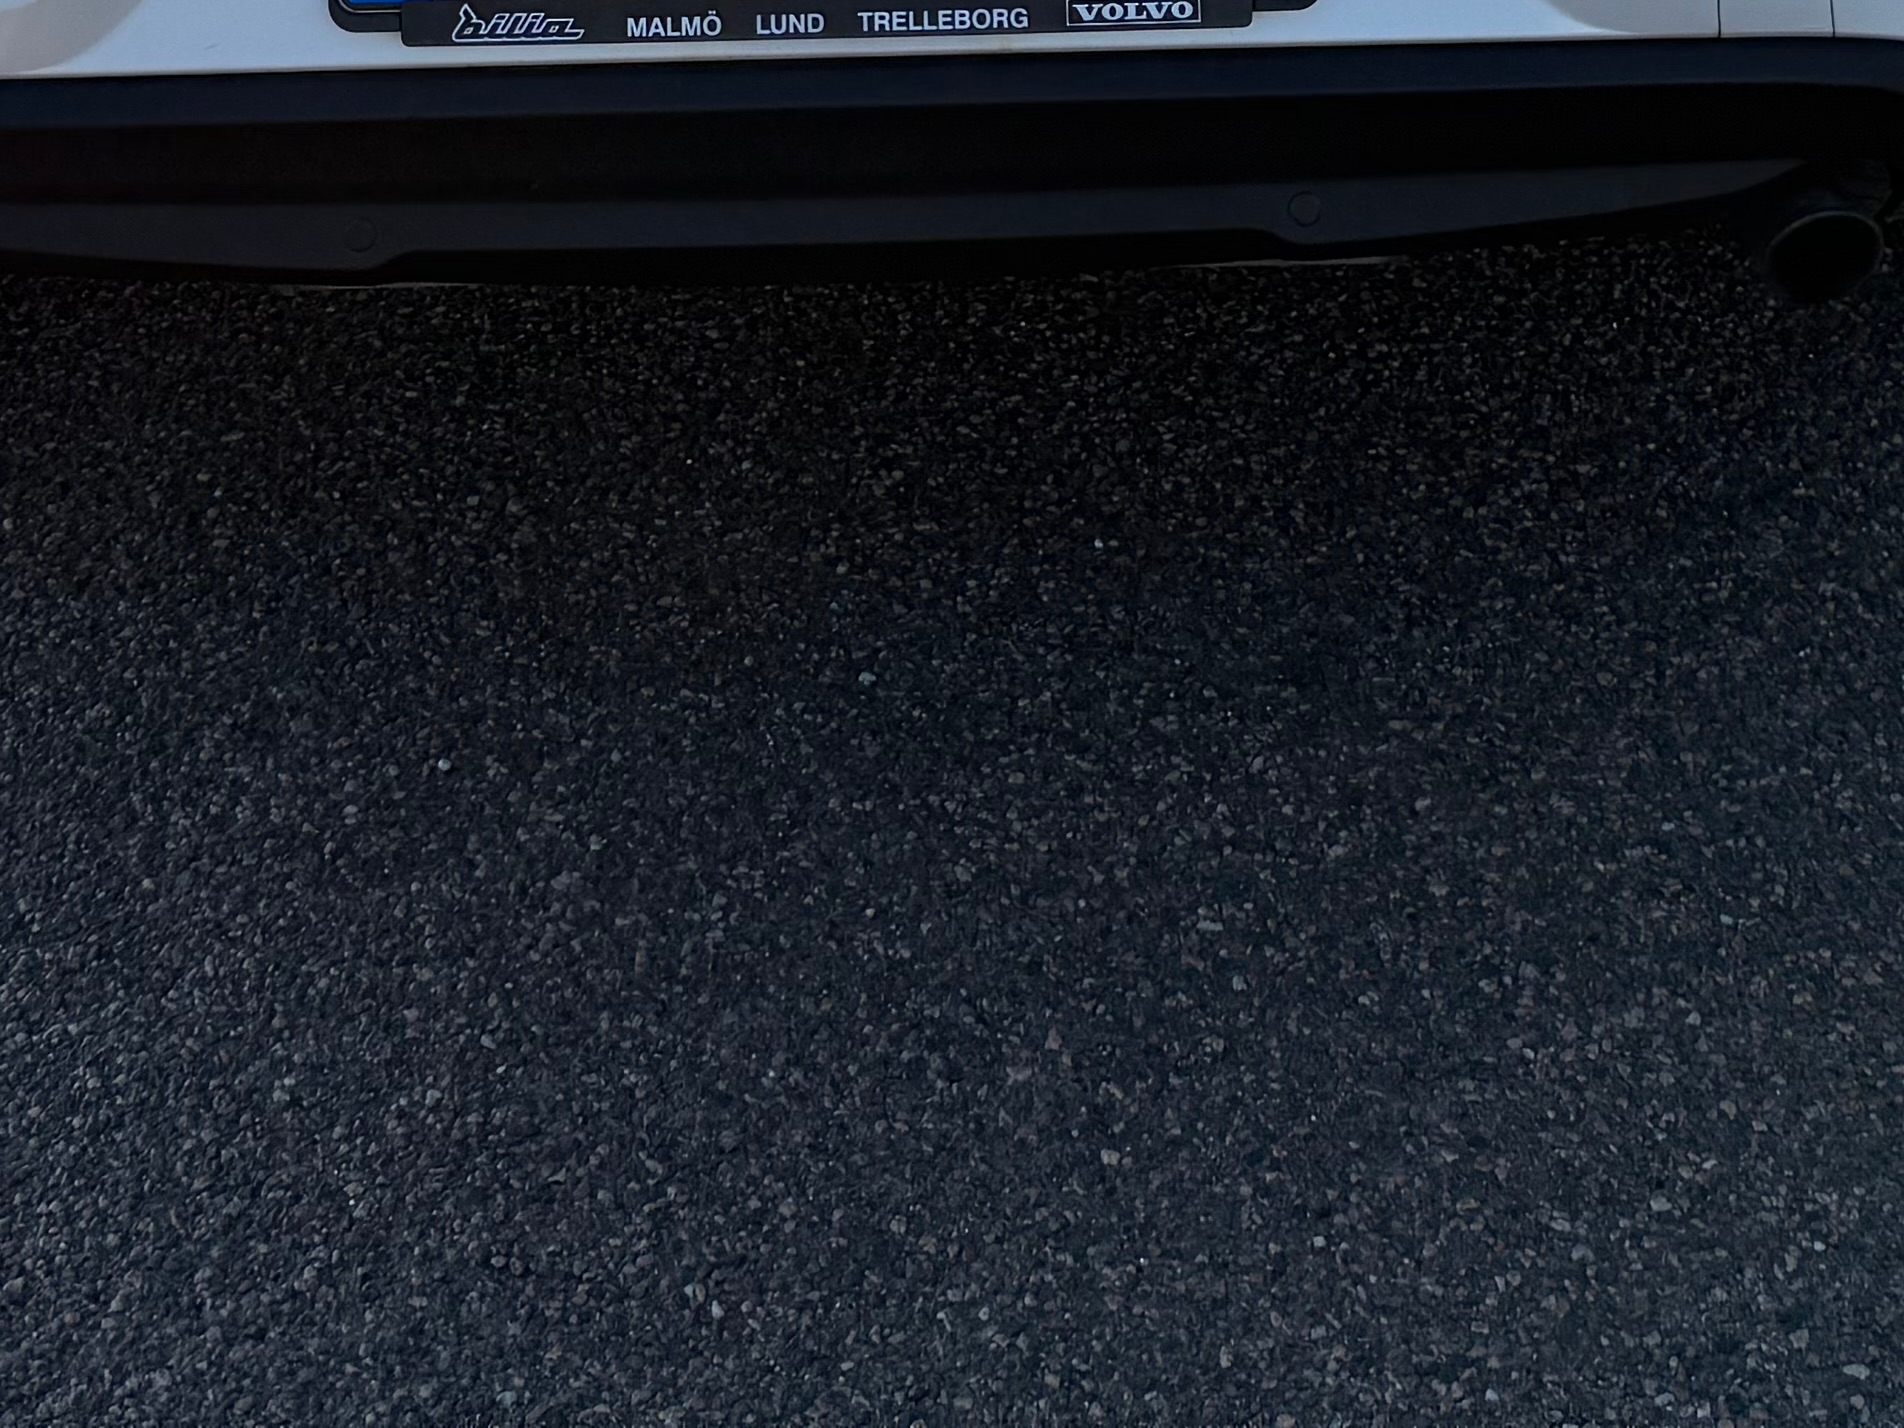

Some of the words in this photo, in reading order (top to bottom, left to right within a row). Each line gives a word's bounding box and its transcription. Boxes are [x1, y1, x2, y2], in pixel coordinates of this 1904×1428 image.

[626, 10, 722, 37] MALMÖ
[755, 12, 825, 35] LUND
[857, 7, 1029, 32] TRELLEBORG
[1072, 0, 1194, 22] VOLVO
